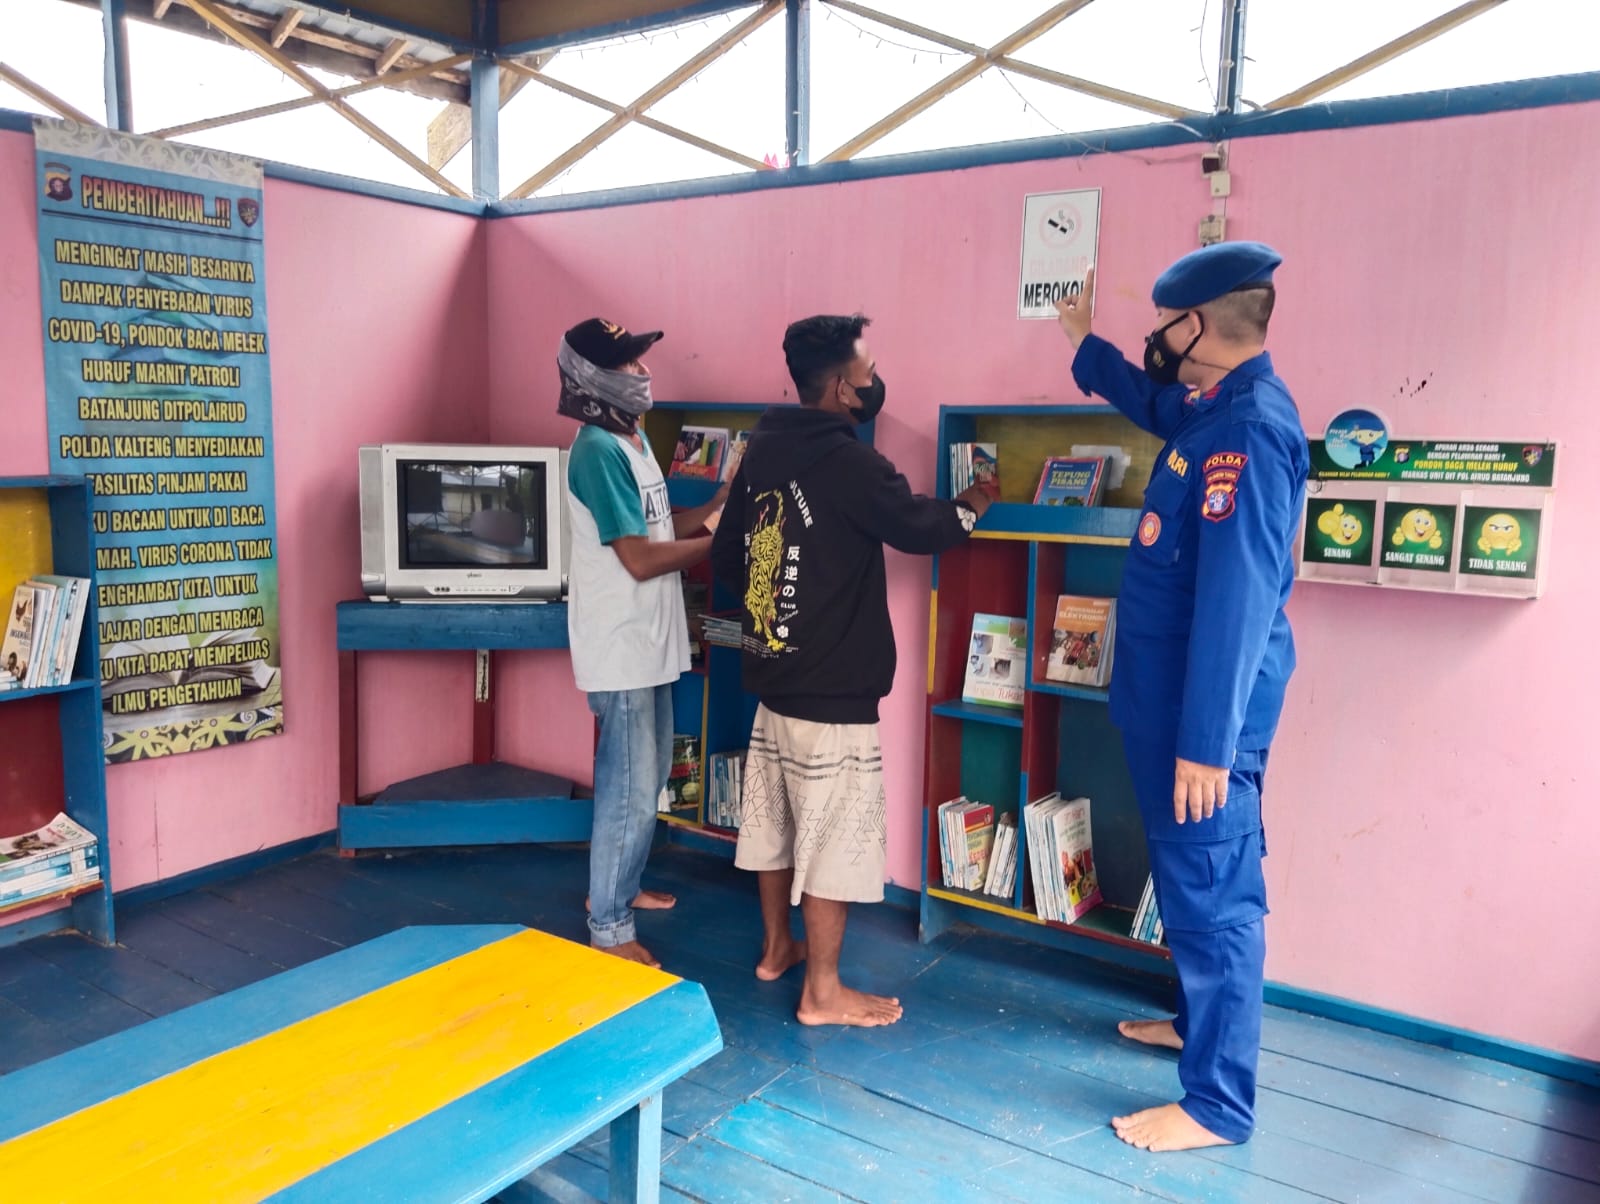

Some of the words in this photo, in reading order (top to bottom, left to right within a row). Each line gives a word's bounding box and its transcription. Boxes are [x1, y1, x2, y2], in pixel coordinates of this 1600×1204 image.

[55, 239, 141, 272] MENGINGAT
[144, 249, 187, 275] MASIH
[190, 256, 255, 283] BESARNYA
[60, 280, 123, 307] DAMPAK
[126, 287, 211, 314] PENYEBARAN
[213, 294, 253, 317] VIRUS
[1024, 280, 1085, 308] MEROKO
[49, 318, 126, 347] COVID-19,
[129, 324, 183, 348] PONDOK
[186, 329, 220, 350] BACA
[223, 332, 265, 353] MELEK
[82, 359, 131, 382] HURUF
[135, 362, 186, 384] MARNIT
[189, 365, 240, 387] PATROLI
[78, 397, 160, 421] BATANJUNG
[163, 400, 246, 422] DITPOLAIRUD
[60, 435, 112, 458] POLDA
[114, 436, 172, 458] KALTENG
[174, 437, 264, 458] MENYEDIAKAN
[1206, 455, 1242, 468] POLDA
[85, 473, 154, 496] ASILITAS
[157, 472, 206, 494] PINJAM
[208, 472, 246, 492] PAKAI
[789, 480, 814, 528] ULTURE
[111, 510, 166, 533] BACAAN
[169, 508, 211, 529] UNTUK
[213, 508, 227, 528] DI
[230, 506, 264, 526] BACA
[96, 548, 136, 570] MAH.
[138, 546, 178, 568] VIRUS
[180, 543, 234, 564] CORONA
[236, 540, 272, 560] TIDAK
[1324, 547, 1352, 558] SENANG
[1386, 552, 1414, 564] SANGAT
[1416, 554, 1444, 566] SENANG
[1468, 558, 1494, 570] TIDAK
[1496, 560, 1527, 572] SENANG
[98, 580, 181, 608] ENGHAMBAT
[183, 578, 211, 598] KITA
[214, 574, 258, 596] UNTUK
[99, 618, 141, 644] LAJAR
[144, 614, 196, 639] DENGAN
[199, 606, 264, 633] MEMBACA
[117, 656, 146, 677] KITA
[149, 650, 189, 672] DAPAT
[194, 639, 270, 667] MEMPELUAS
[112, 693, 146, 714] ILMU
[149, 678, 242, 710] PENGETAHUAN
